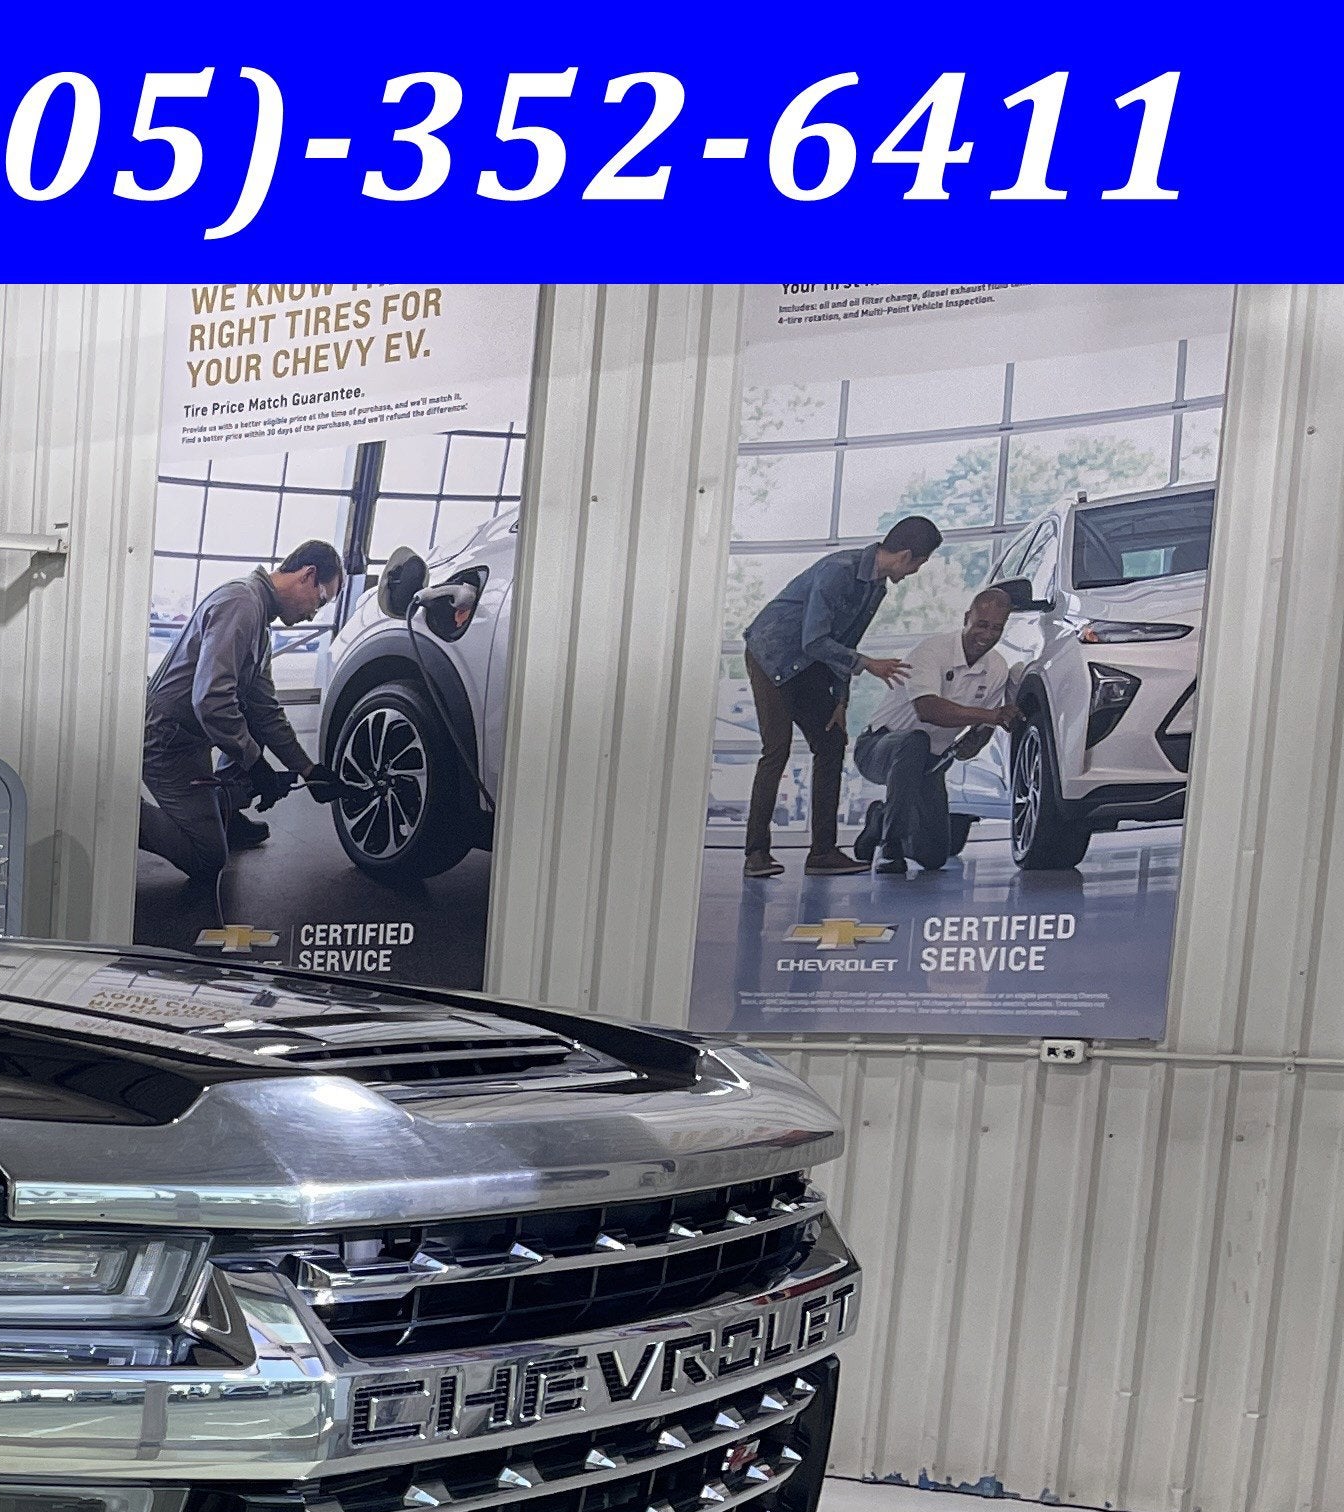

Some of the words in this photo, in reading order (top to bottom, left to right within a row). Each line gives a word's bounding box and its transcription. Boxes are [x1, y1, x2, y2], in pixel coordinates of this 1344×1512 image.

[192, 284, 236, 314] WE
[190, 314, 276, 352] RIGHT
[285, 300, 371, 339] TIRES
[382, 288, 442, 325] FOR
[187, 354, 261, 388] YOUR
[272, 336, 375, 378] CHEVY
[385, 329, 430, 363] EV.
[184, 404, 208, 418] Tire
[212, 401, 244, 415] Price
[248, 394, 288, 412] Match
[292, 388, 365, 406] Guarantee.
[300, 923, 414, 946] CERTIFIED
[923, 914, 1076, 942] CERTIFIED
[298, 950, 392, 972] SERVICE
[776, 959, 899, 972] CHEVROLET
[920, 946, 1046, 972] SERVICE
[350, 1284, 856, 1447] CHEVROLET
